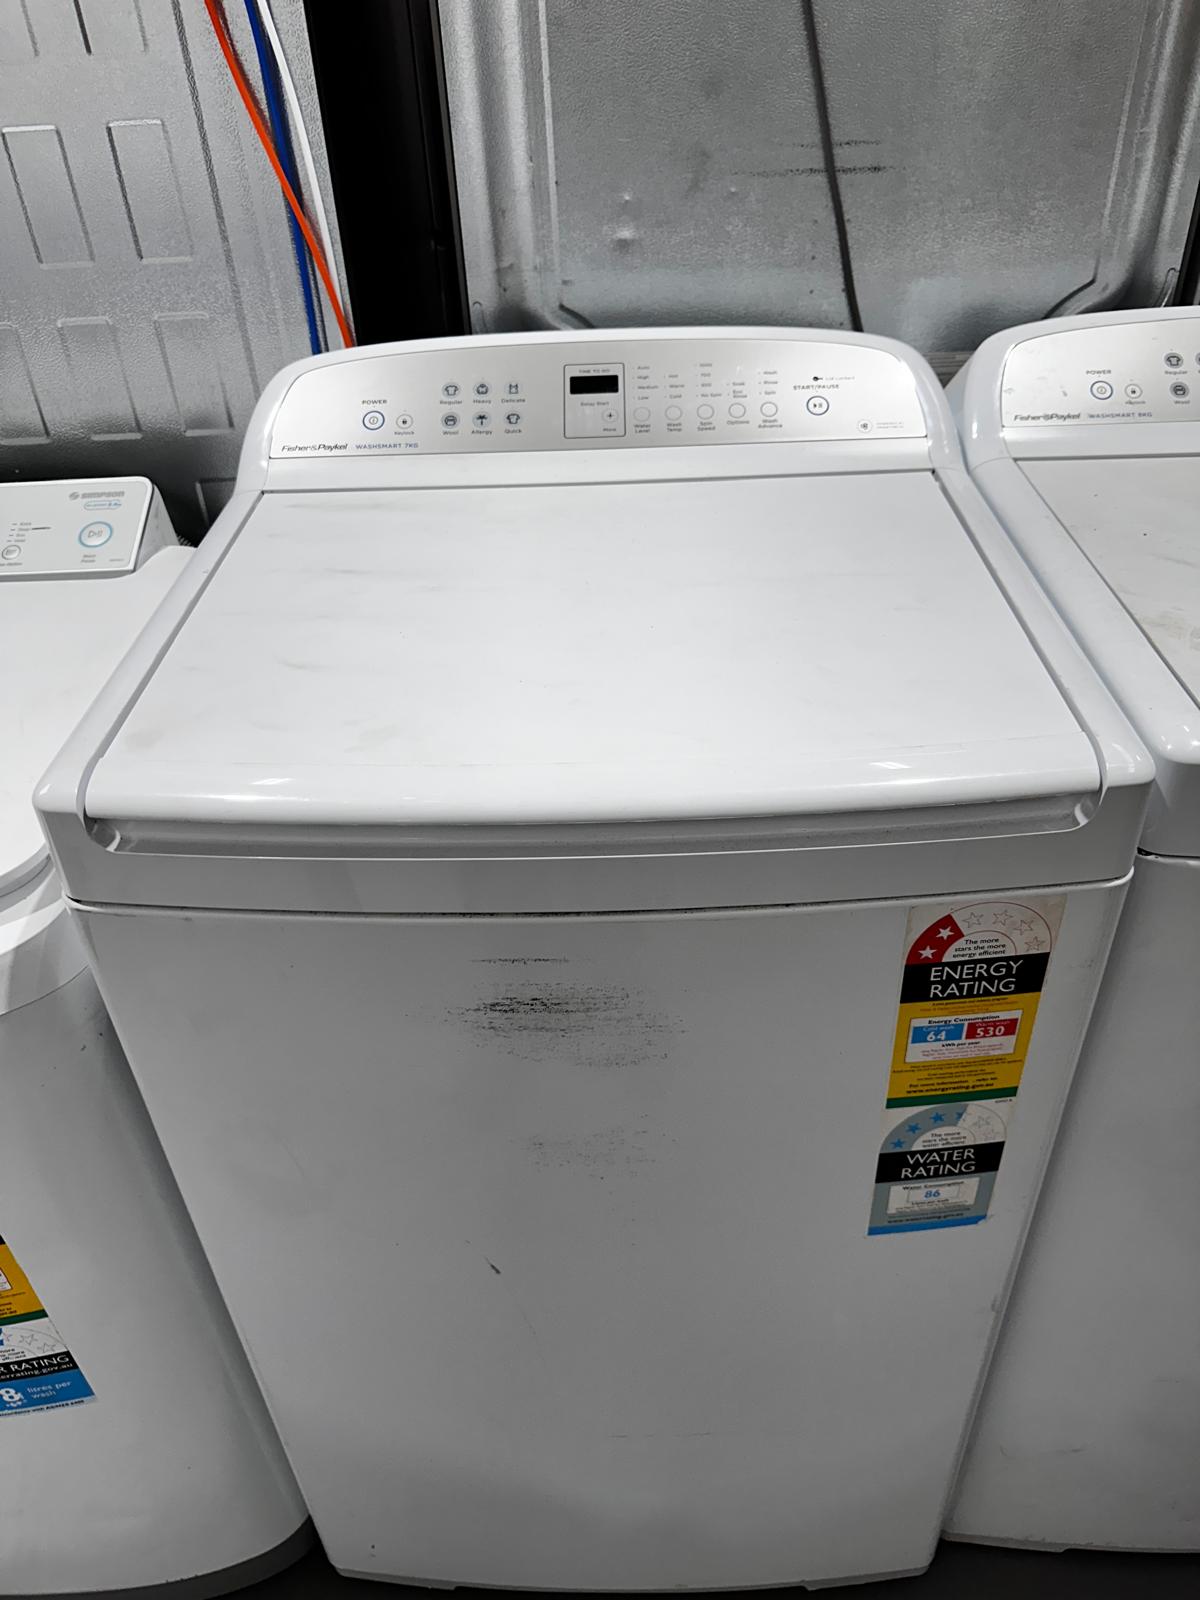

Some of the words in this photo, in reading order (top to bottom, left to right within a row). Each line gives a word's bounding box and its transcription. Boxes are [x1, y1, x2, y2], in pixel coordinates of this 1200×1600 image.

[930, 960, 1024, 981] ENERGY
[929, 978, 1016, 999] RATING
[953, 1015, 1000, 1023] Consumption
[926, 1032, 946, 1042] 64
[976, 1026, 1005, 1037] 530
[907, 1148, 975, 1164] WATER
[901, 1162, 976, 1178] RATING
[924, 1190, 940, 1198] 86
[10, 1355, 69, 1372] RATING
[27, 1384, 52, 1393] litres
[56, 1381, 72, 1389] per
[31, 1390, 56, 1398] wash
